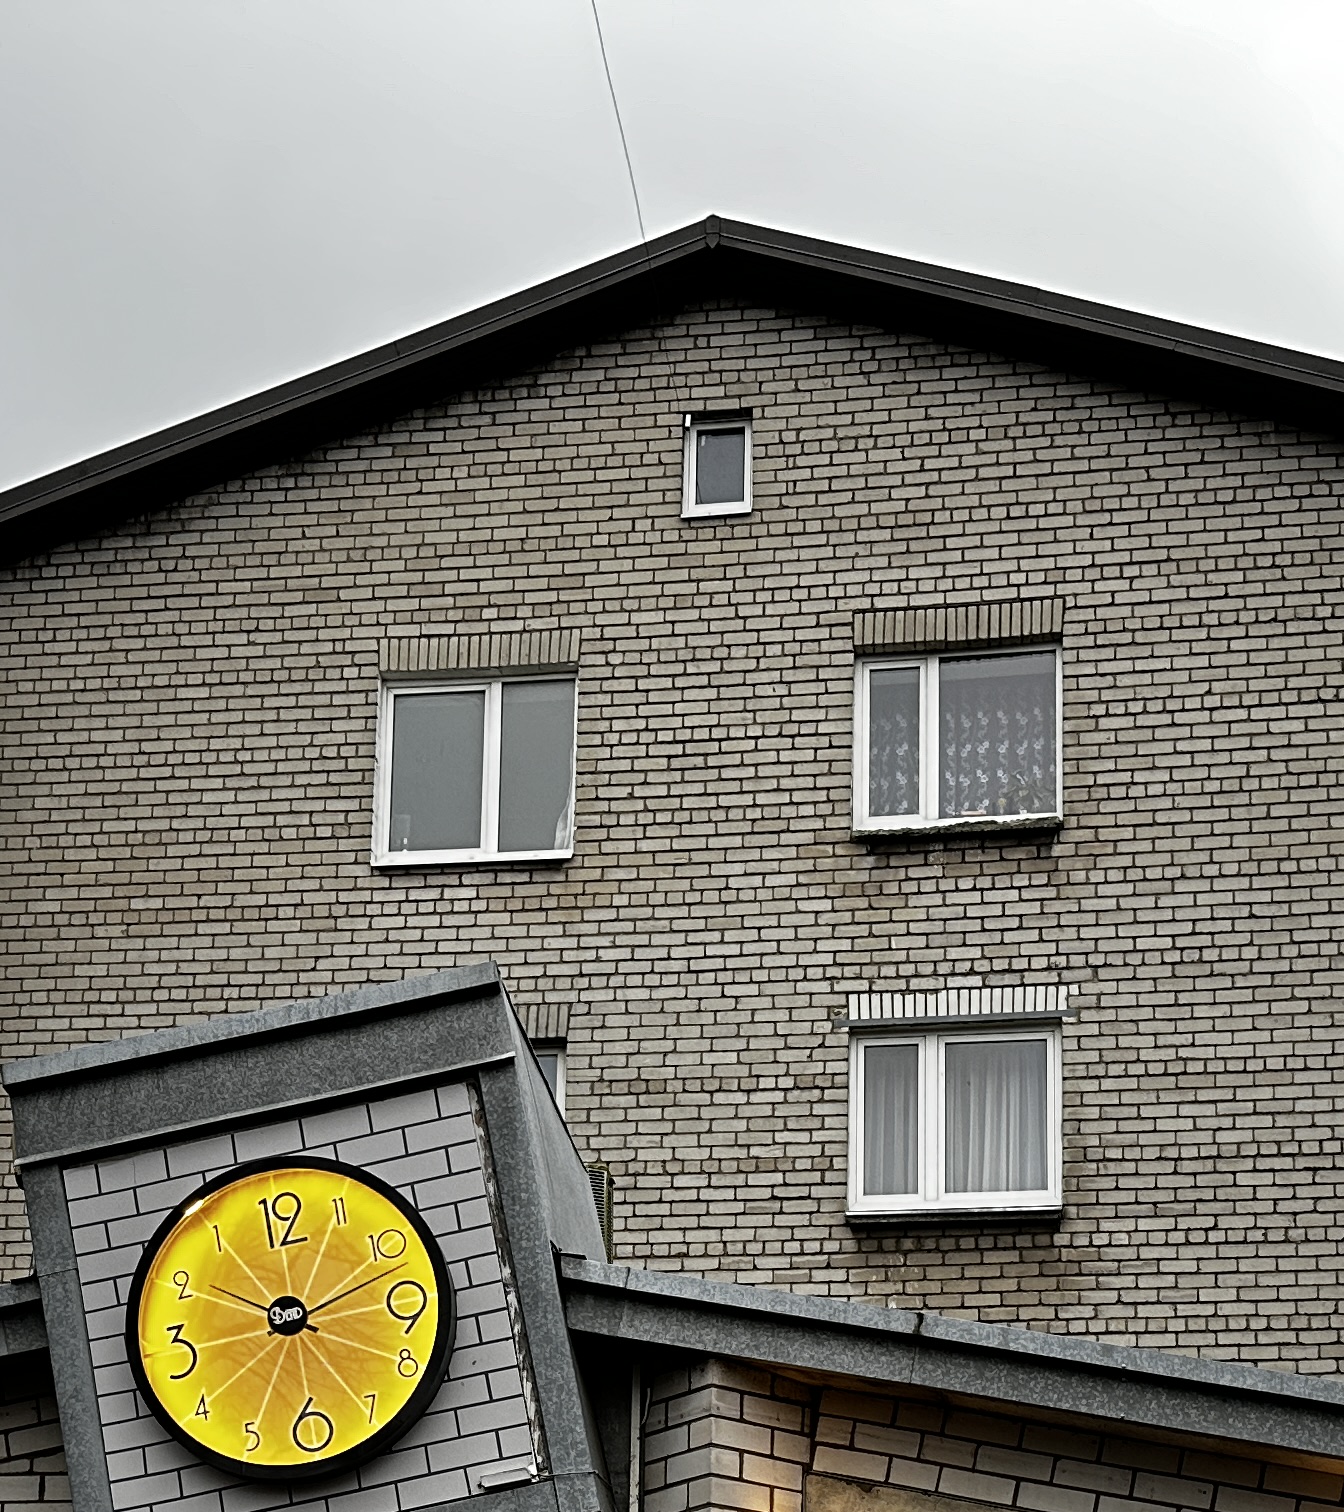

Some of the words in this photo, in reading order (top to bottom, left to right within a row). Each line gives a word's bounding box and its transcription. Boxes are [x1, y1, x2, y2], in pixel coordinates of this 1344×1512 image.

[257, 1191, 308, 1250] 12
[331, 1196, 349, 1227] 11
[212, 1224, 224, 1253] 1
[368, 1228, 407, 1263] 10
[173, 1270, 195, 1301] 2
[386, 1280, 427, 1335] 9
[166, 1324, 198, 1380] 3
[397, 1348, 419, 1378] 8
[194, 1393, 211, 1421] 4
[363, 1394, 378, 1424] 7
[243, 1421, 261, 1452] 5
[292, 1396, 334, 1453] 6
